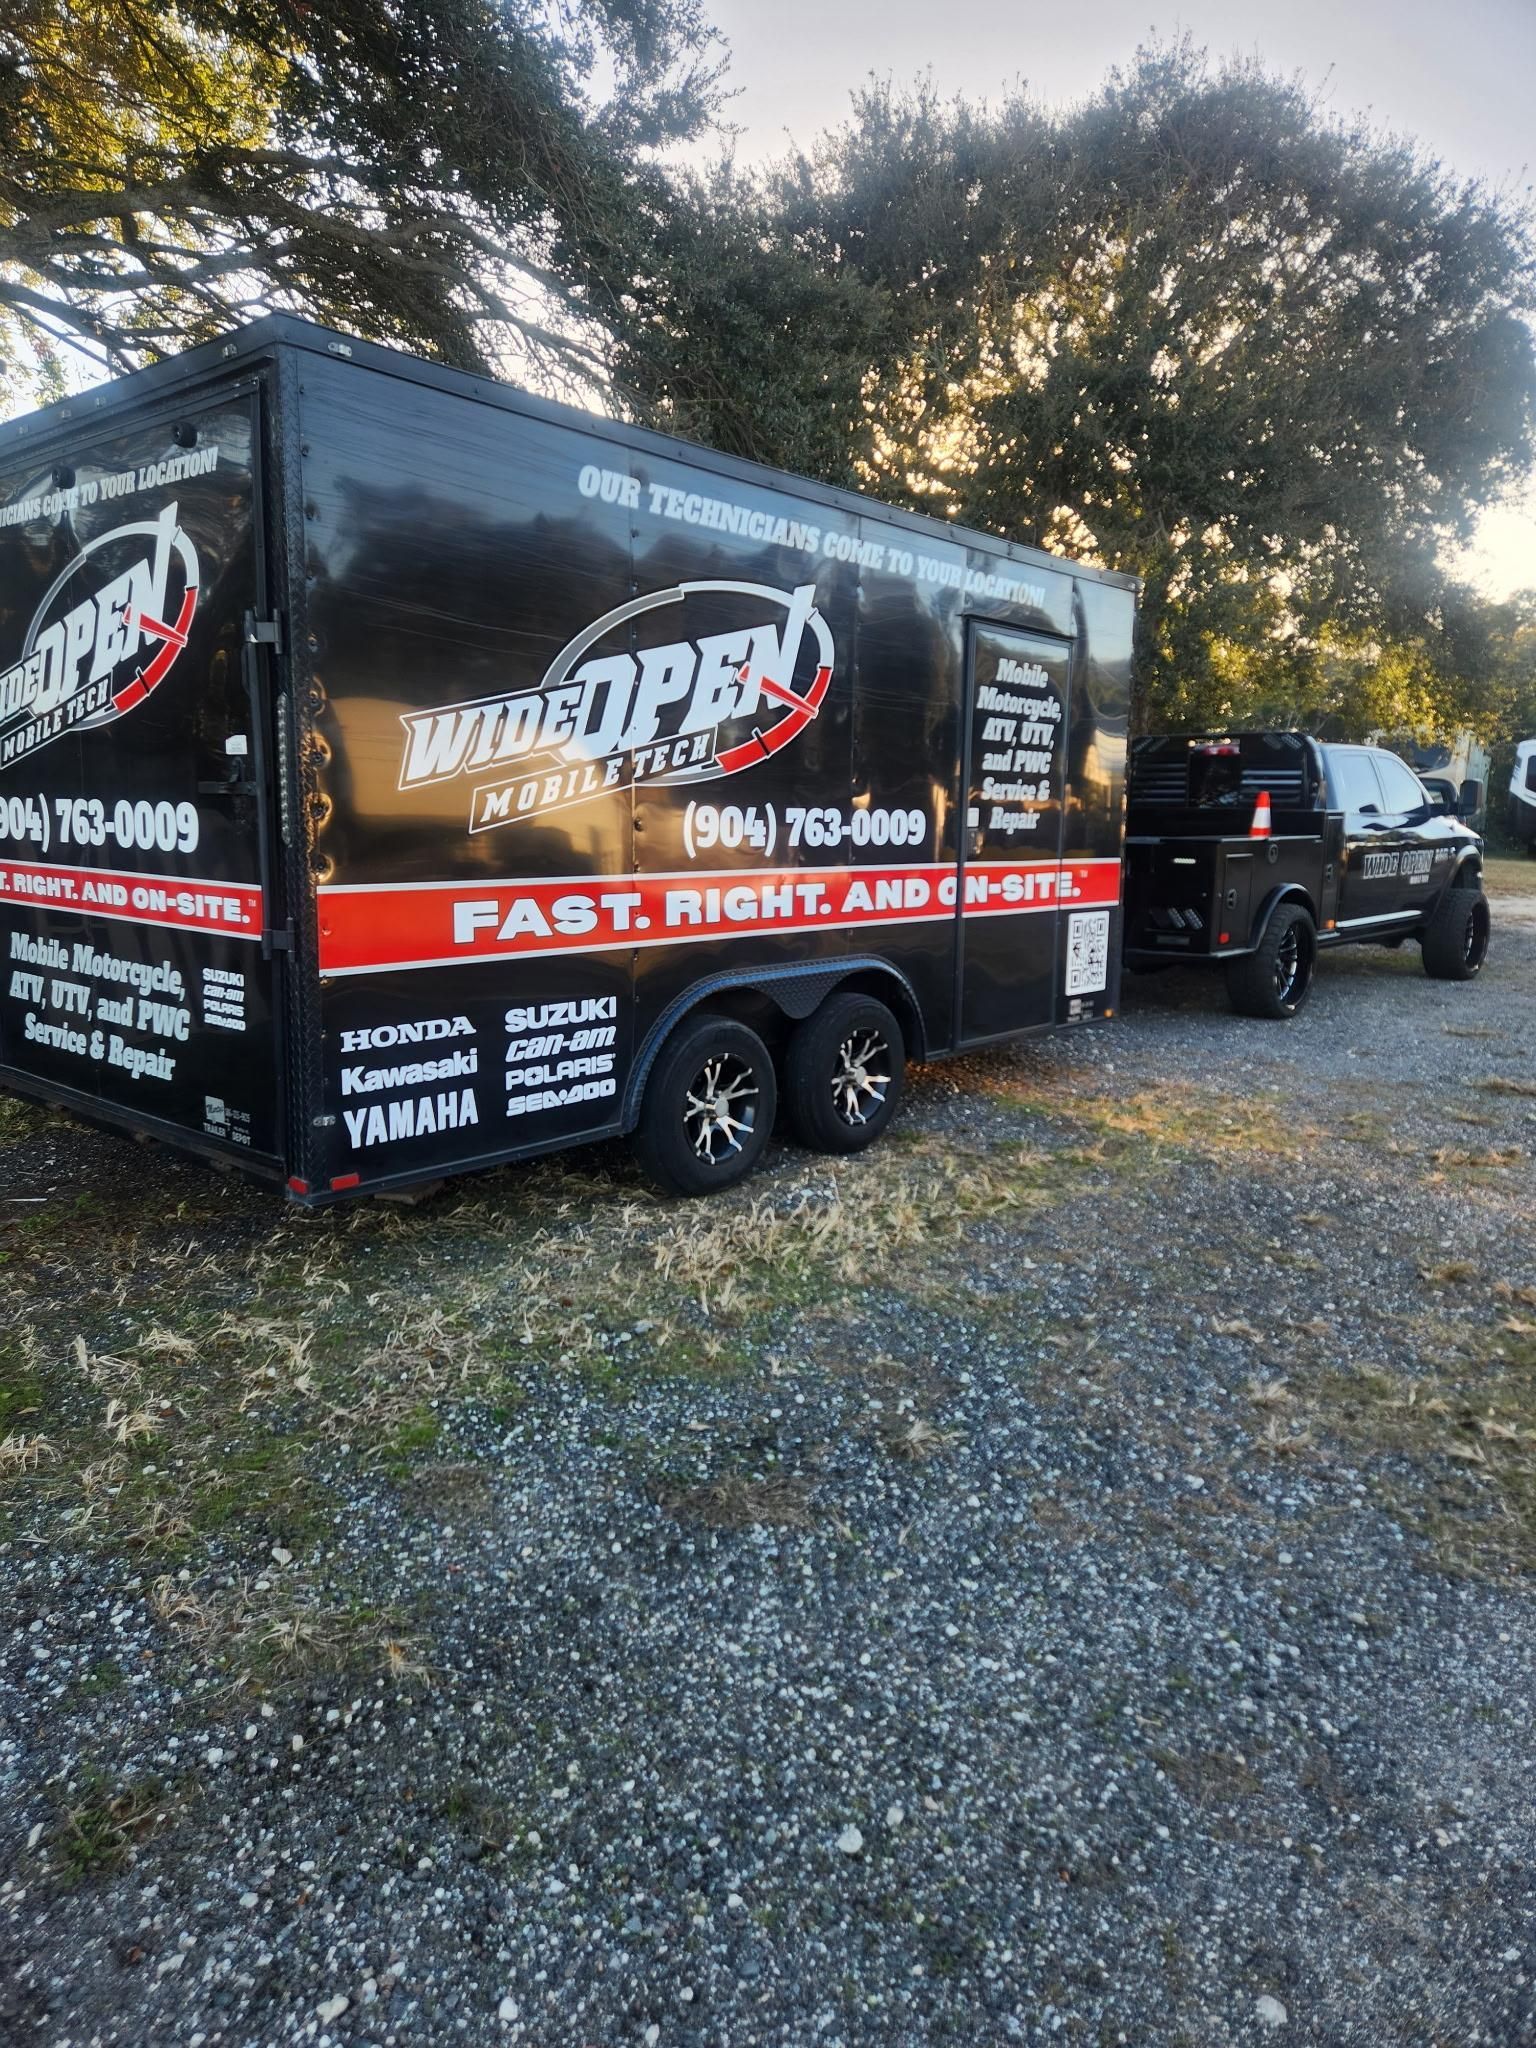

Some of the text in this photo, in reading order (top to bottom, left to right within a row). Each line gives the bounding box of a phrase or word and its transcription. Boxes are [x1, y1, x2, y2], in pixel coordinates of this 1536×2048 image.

[0, 446, 219, 528] ICIANS COME TO YOUR LOCATION!
[577, 464, 1046, 607] OUR TECHNICIANS COME TO YOUR LOCATION!
[30, 501, 178, 716] OPEN
[563, 584, 817, 761] OPEN
[995, 657, 1049, 688] Mobile
[3, 678, 109, 762] MOBILE TECH
[976, 685, 1062, 722] Motorcycle,
[981, 717, 1055, 750] ATV, UTV,
[480, 732, 714, 823] MOBILE TECH
[981, 749, 1052, 774] and PWC
[980, 776, 1050, 801] Service &
[55, 798, 199, 853] 763-0009
[683, 801, 926, 859] (904) 763-0009
[988, 806, 1041, 835] Repair
[1363, 852, 1400, 879] WIDE
[1401, 849, 1434, 876] OPEN
[13, 872, 79, 900] RIGHT.
[82, 881, 128, 907] AND
[132, 887, 251, 924] ON-SITE.
[453, 892, 651, 944] FAST.
[666, 883, 831, 926] RIGHT.
[841, 878, 930, 913] AND
[938, 871, 1081, 906] ON-SITE.
[10, 931, 186, 1002] Mobile Motorcycle,
[203, 968, 244, 987] SUZUKI
[9, 970, 191, 1041] ATV, UTV, and PWC
[505, 996, 616, 1033] SUZUKI
[24, 1012, 177, 1081] Service & Repair
[340, 1016, 477, 1052] HONDA
[341, 1048, 478, 1096] Kawasaki
[505, 1053, 615, 1091] POLARIS
[343, 1088, 479, 1149] YAMAHA
